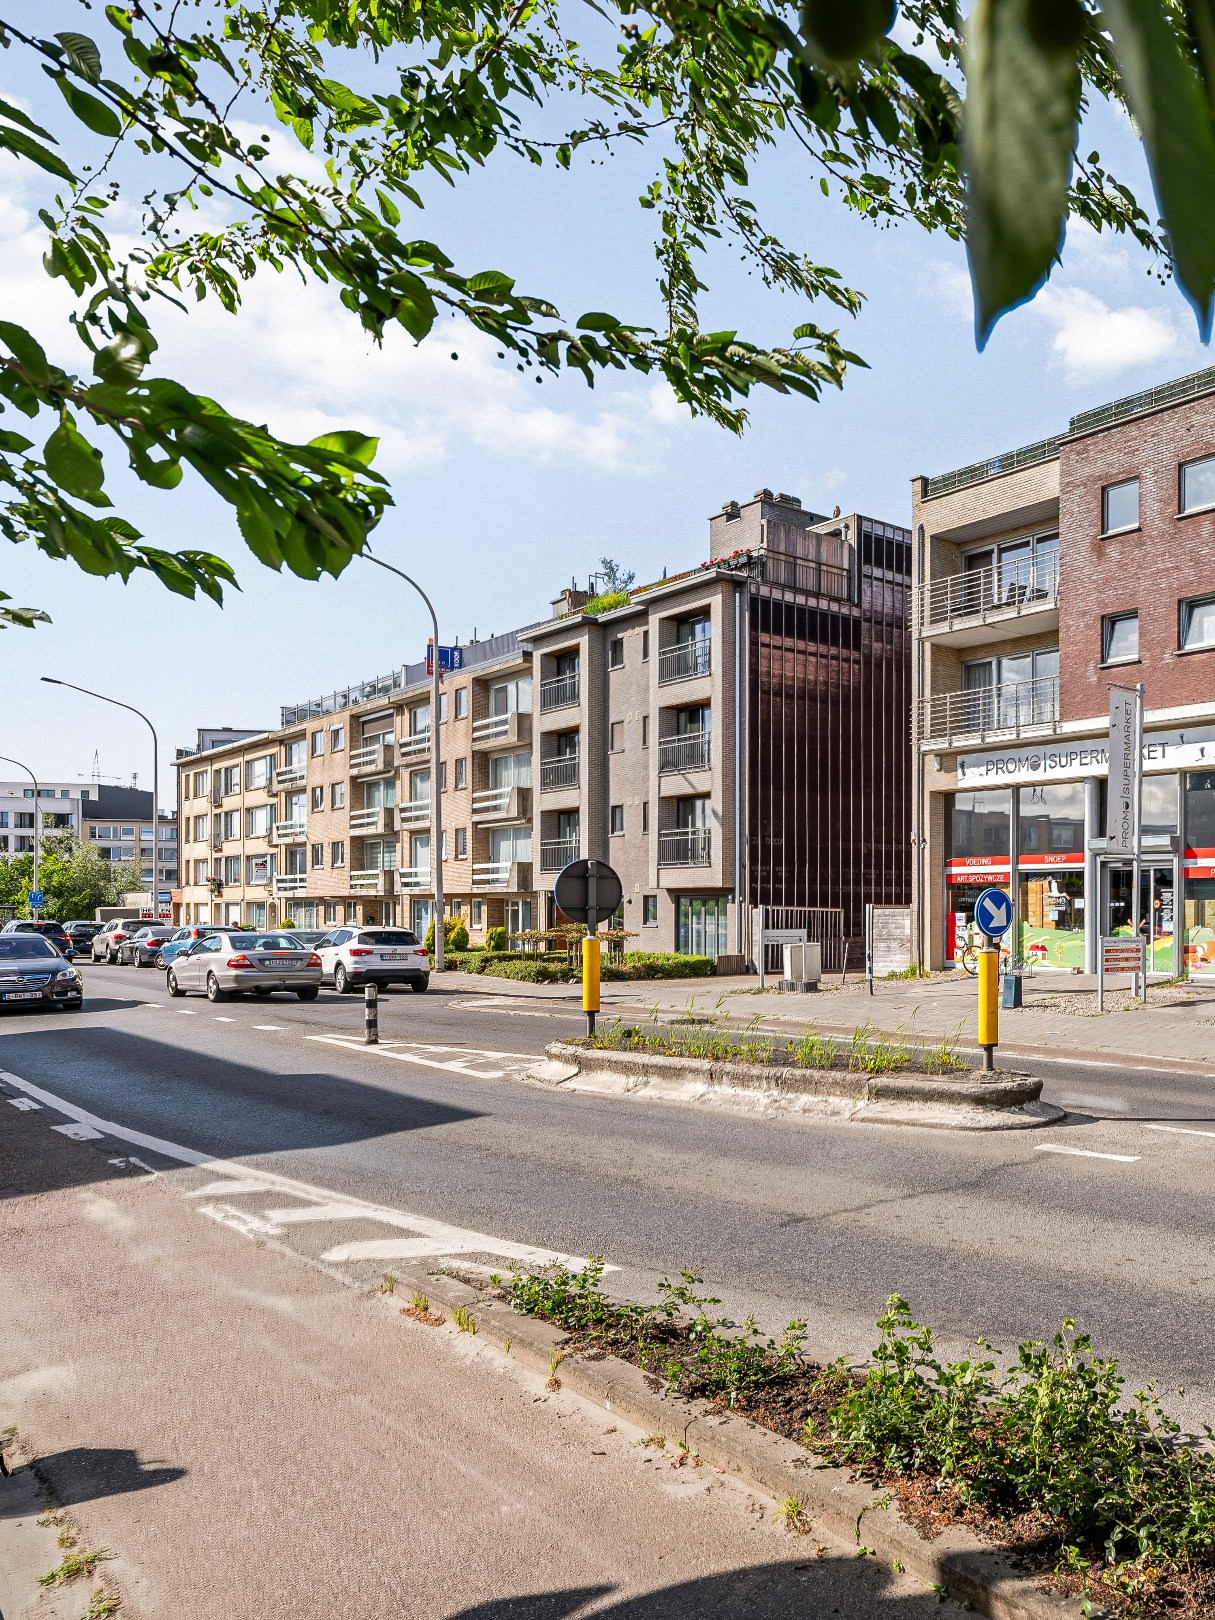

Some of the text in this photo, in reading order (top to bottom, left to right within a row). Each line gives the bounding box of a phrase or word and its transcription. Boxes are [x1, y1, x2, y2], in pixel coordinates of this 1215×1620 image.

[985, 742, 1169, 776] PROMO SUPERMKET
[1121, 699, 1132, 849] PROMO SUPERMARKET
[965, 858, 992, 866] VOEDING
